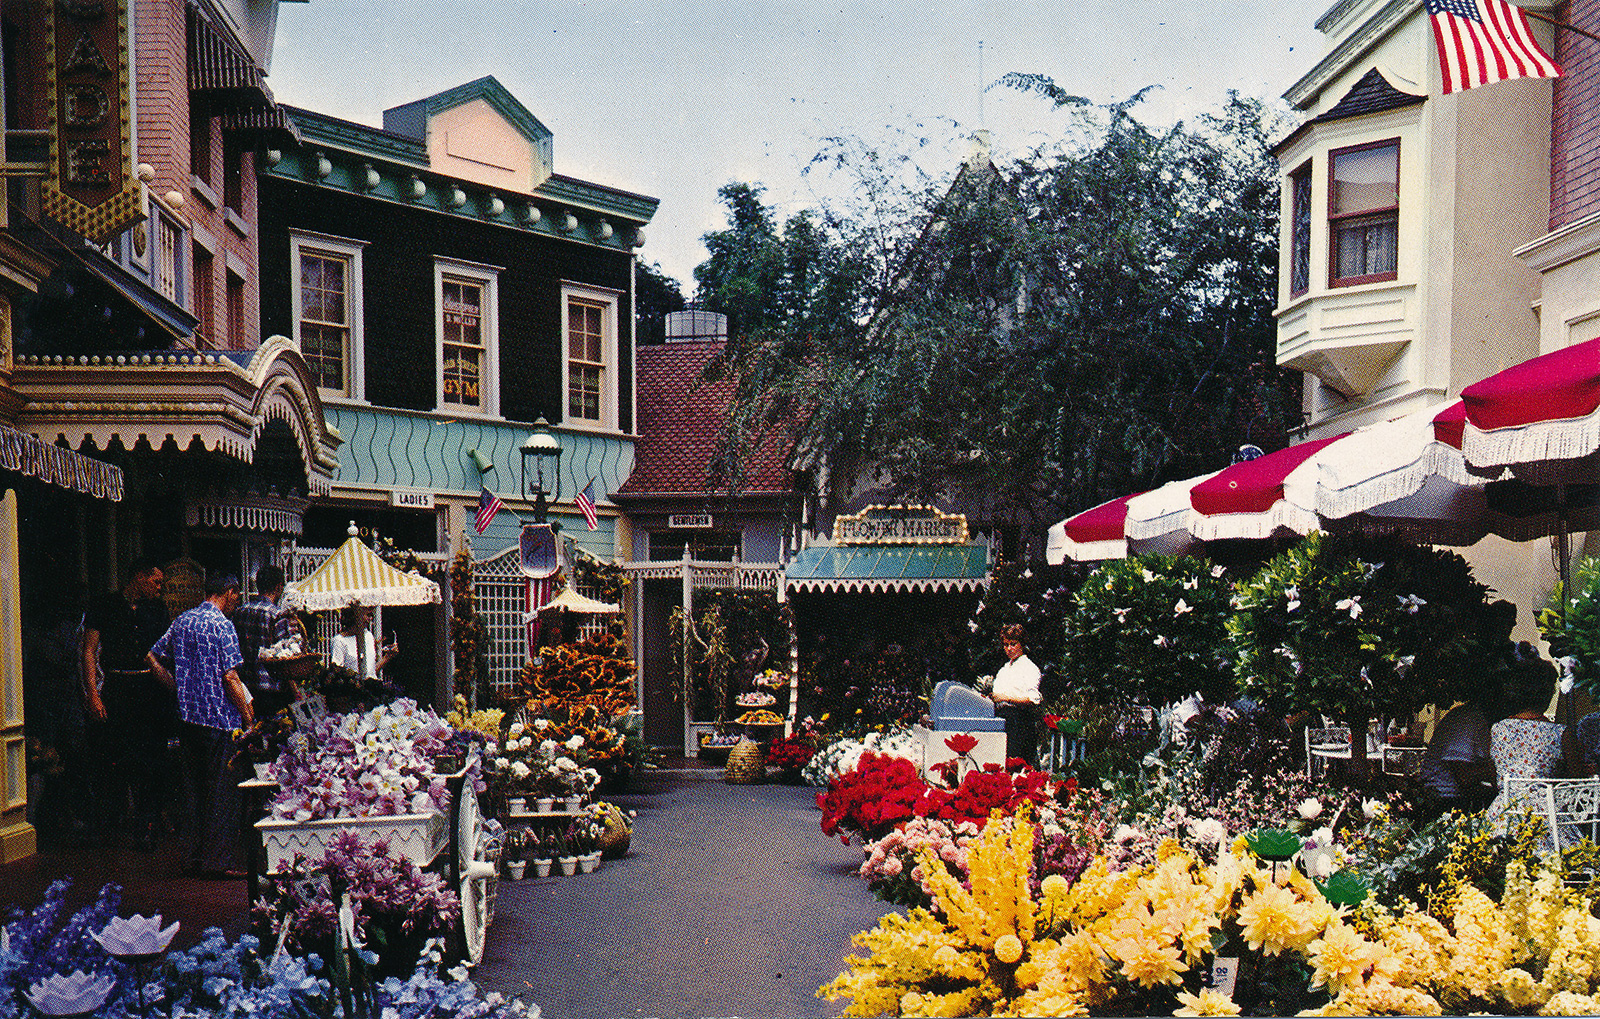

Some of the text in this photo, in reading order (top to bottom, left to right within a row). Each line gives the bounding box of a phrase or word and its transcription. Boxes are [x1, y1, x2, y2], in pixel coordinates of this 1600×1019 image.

[444, 379, 479, 398] GYM
[399, 494, 429, 506] LADIES
[902, 520, 960, 537] MARKET
